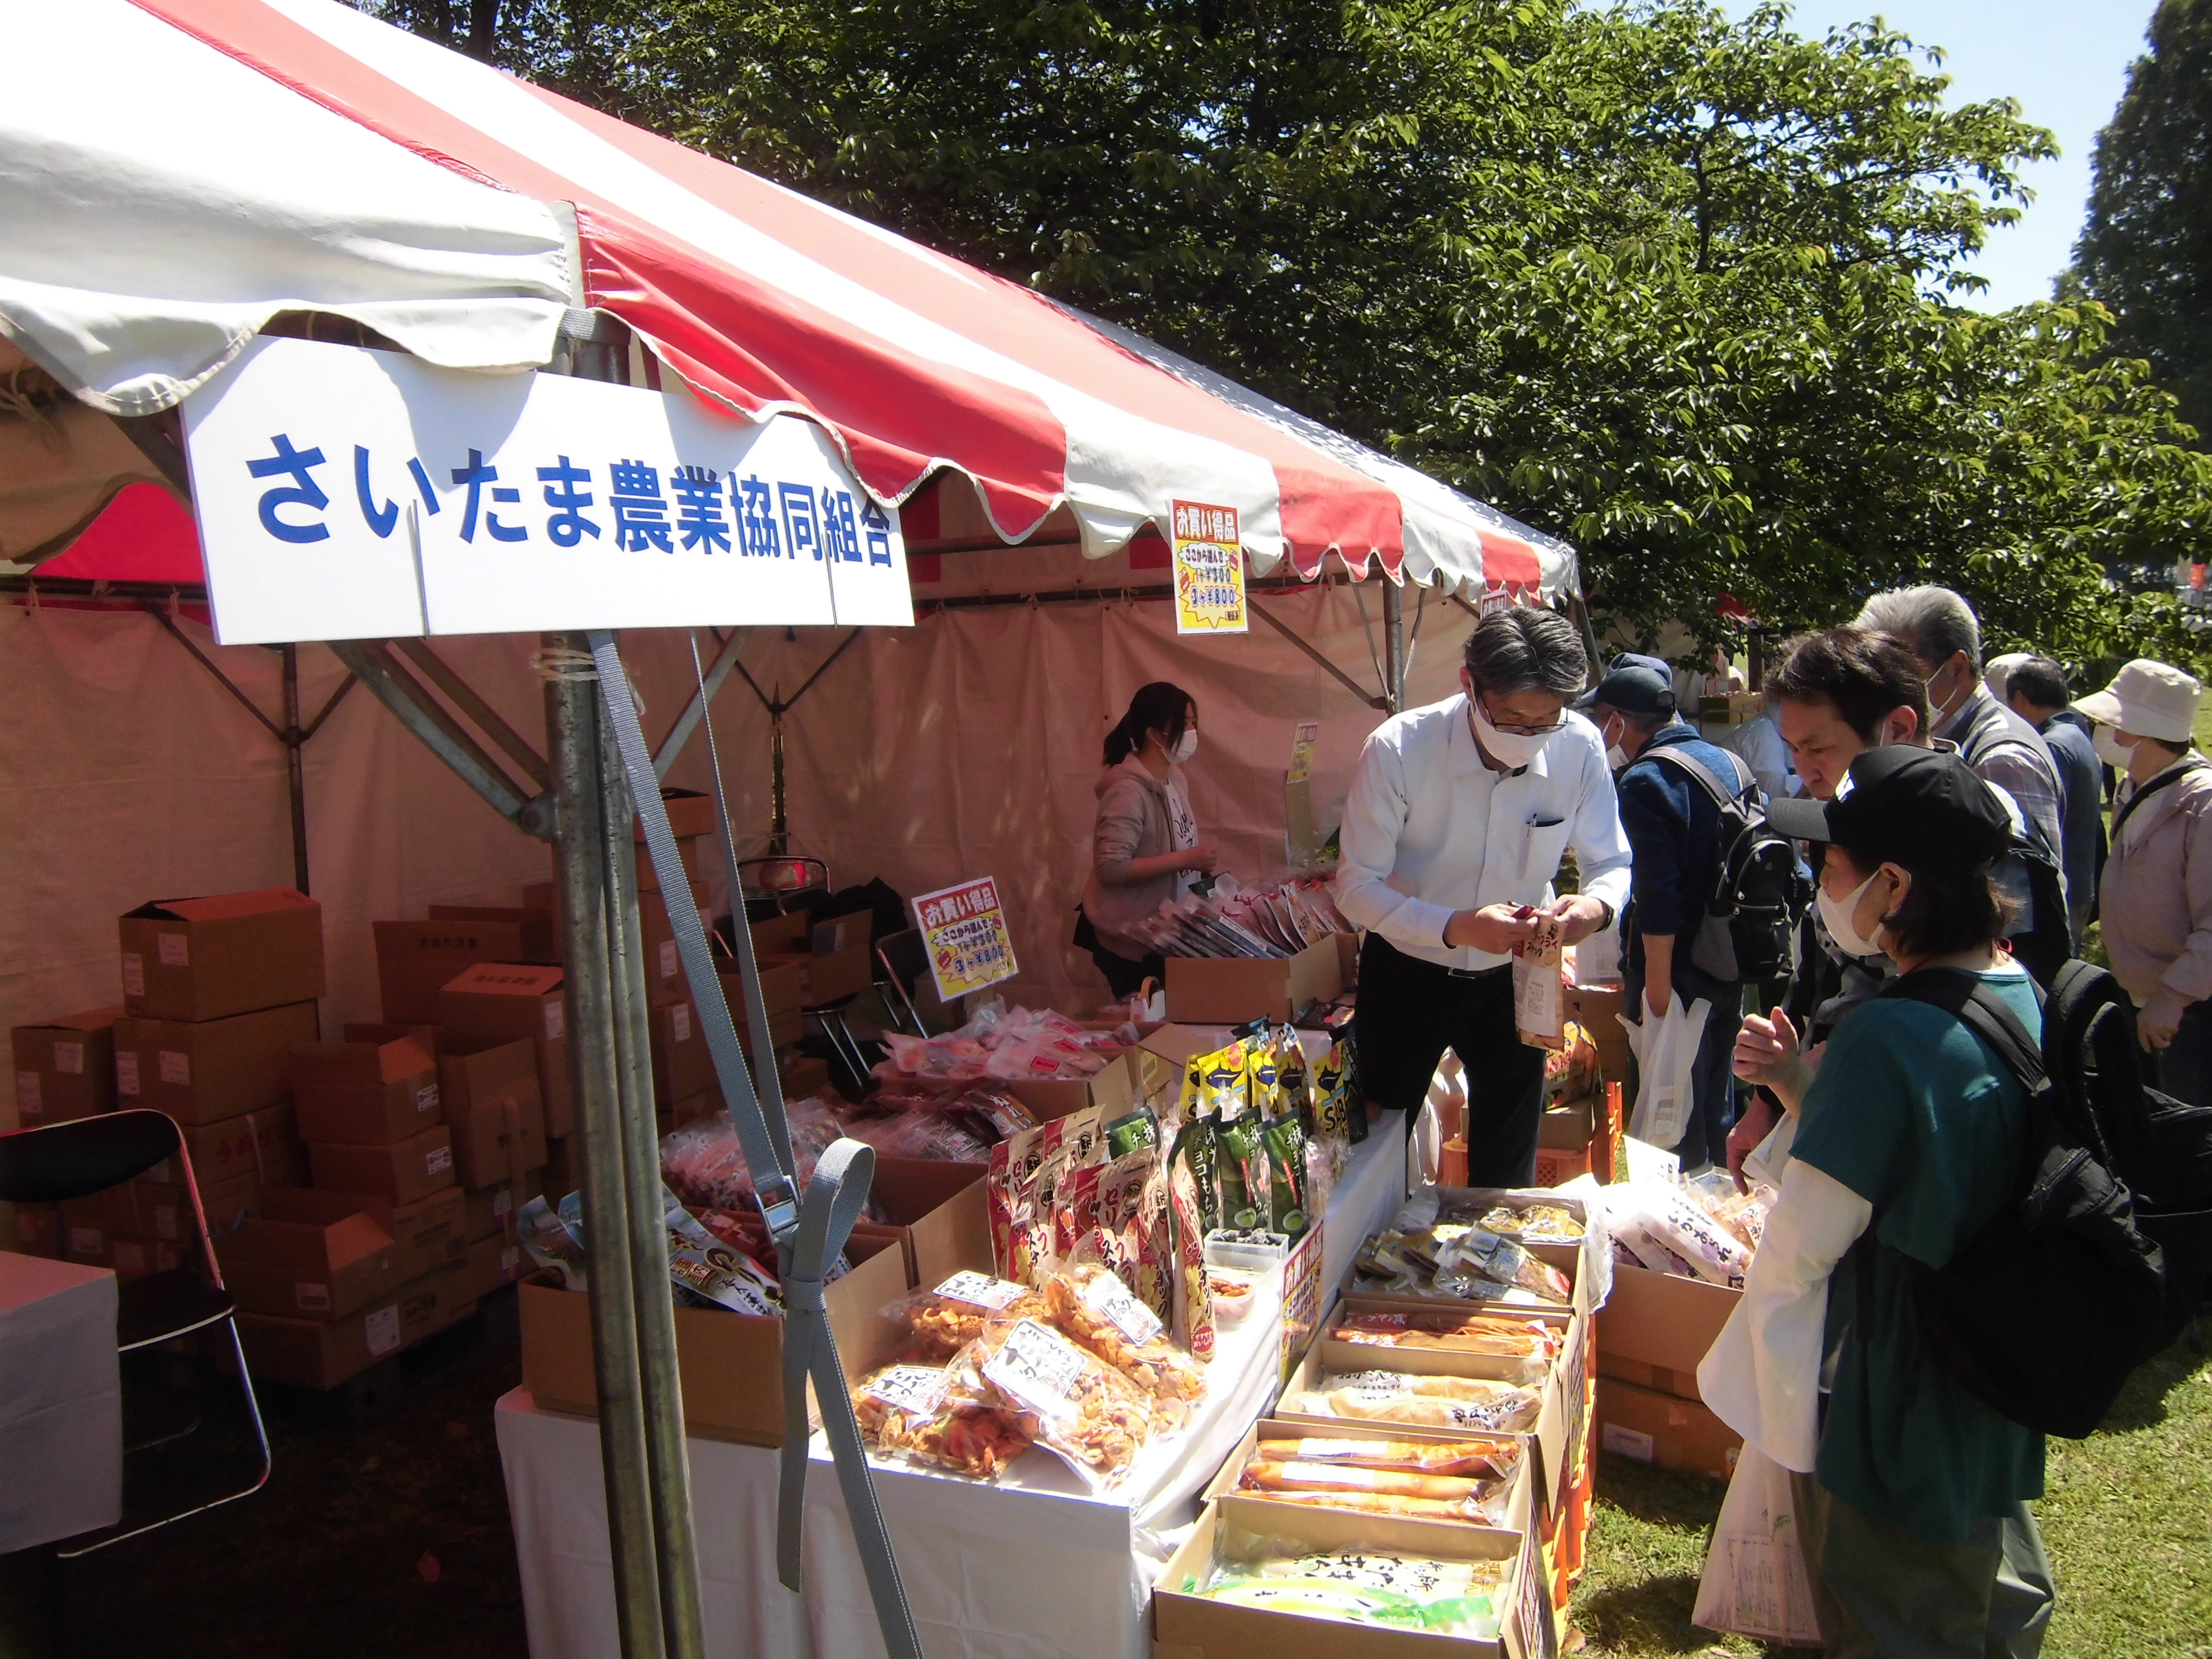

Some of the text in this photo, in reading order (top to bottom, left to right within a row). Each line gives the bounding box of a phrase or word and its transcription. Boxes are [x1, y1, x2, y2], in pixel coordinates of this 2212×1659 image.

[246, 433, 892, 568] さいたま農業協同組合
[1176, 505, 1237, 542] お買い得品
[925, 886, 996, 928] お買い得品
[1668, 1210, 1733, 1263] いかあられ
